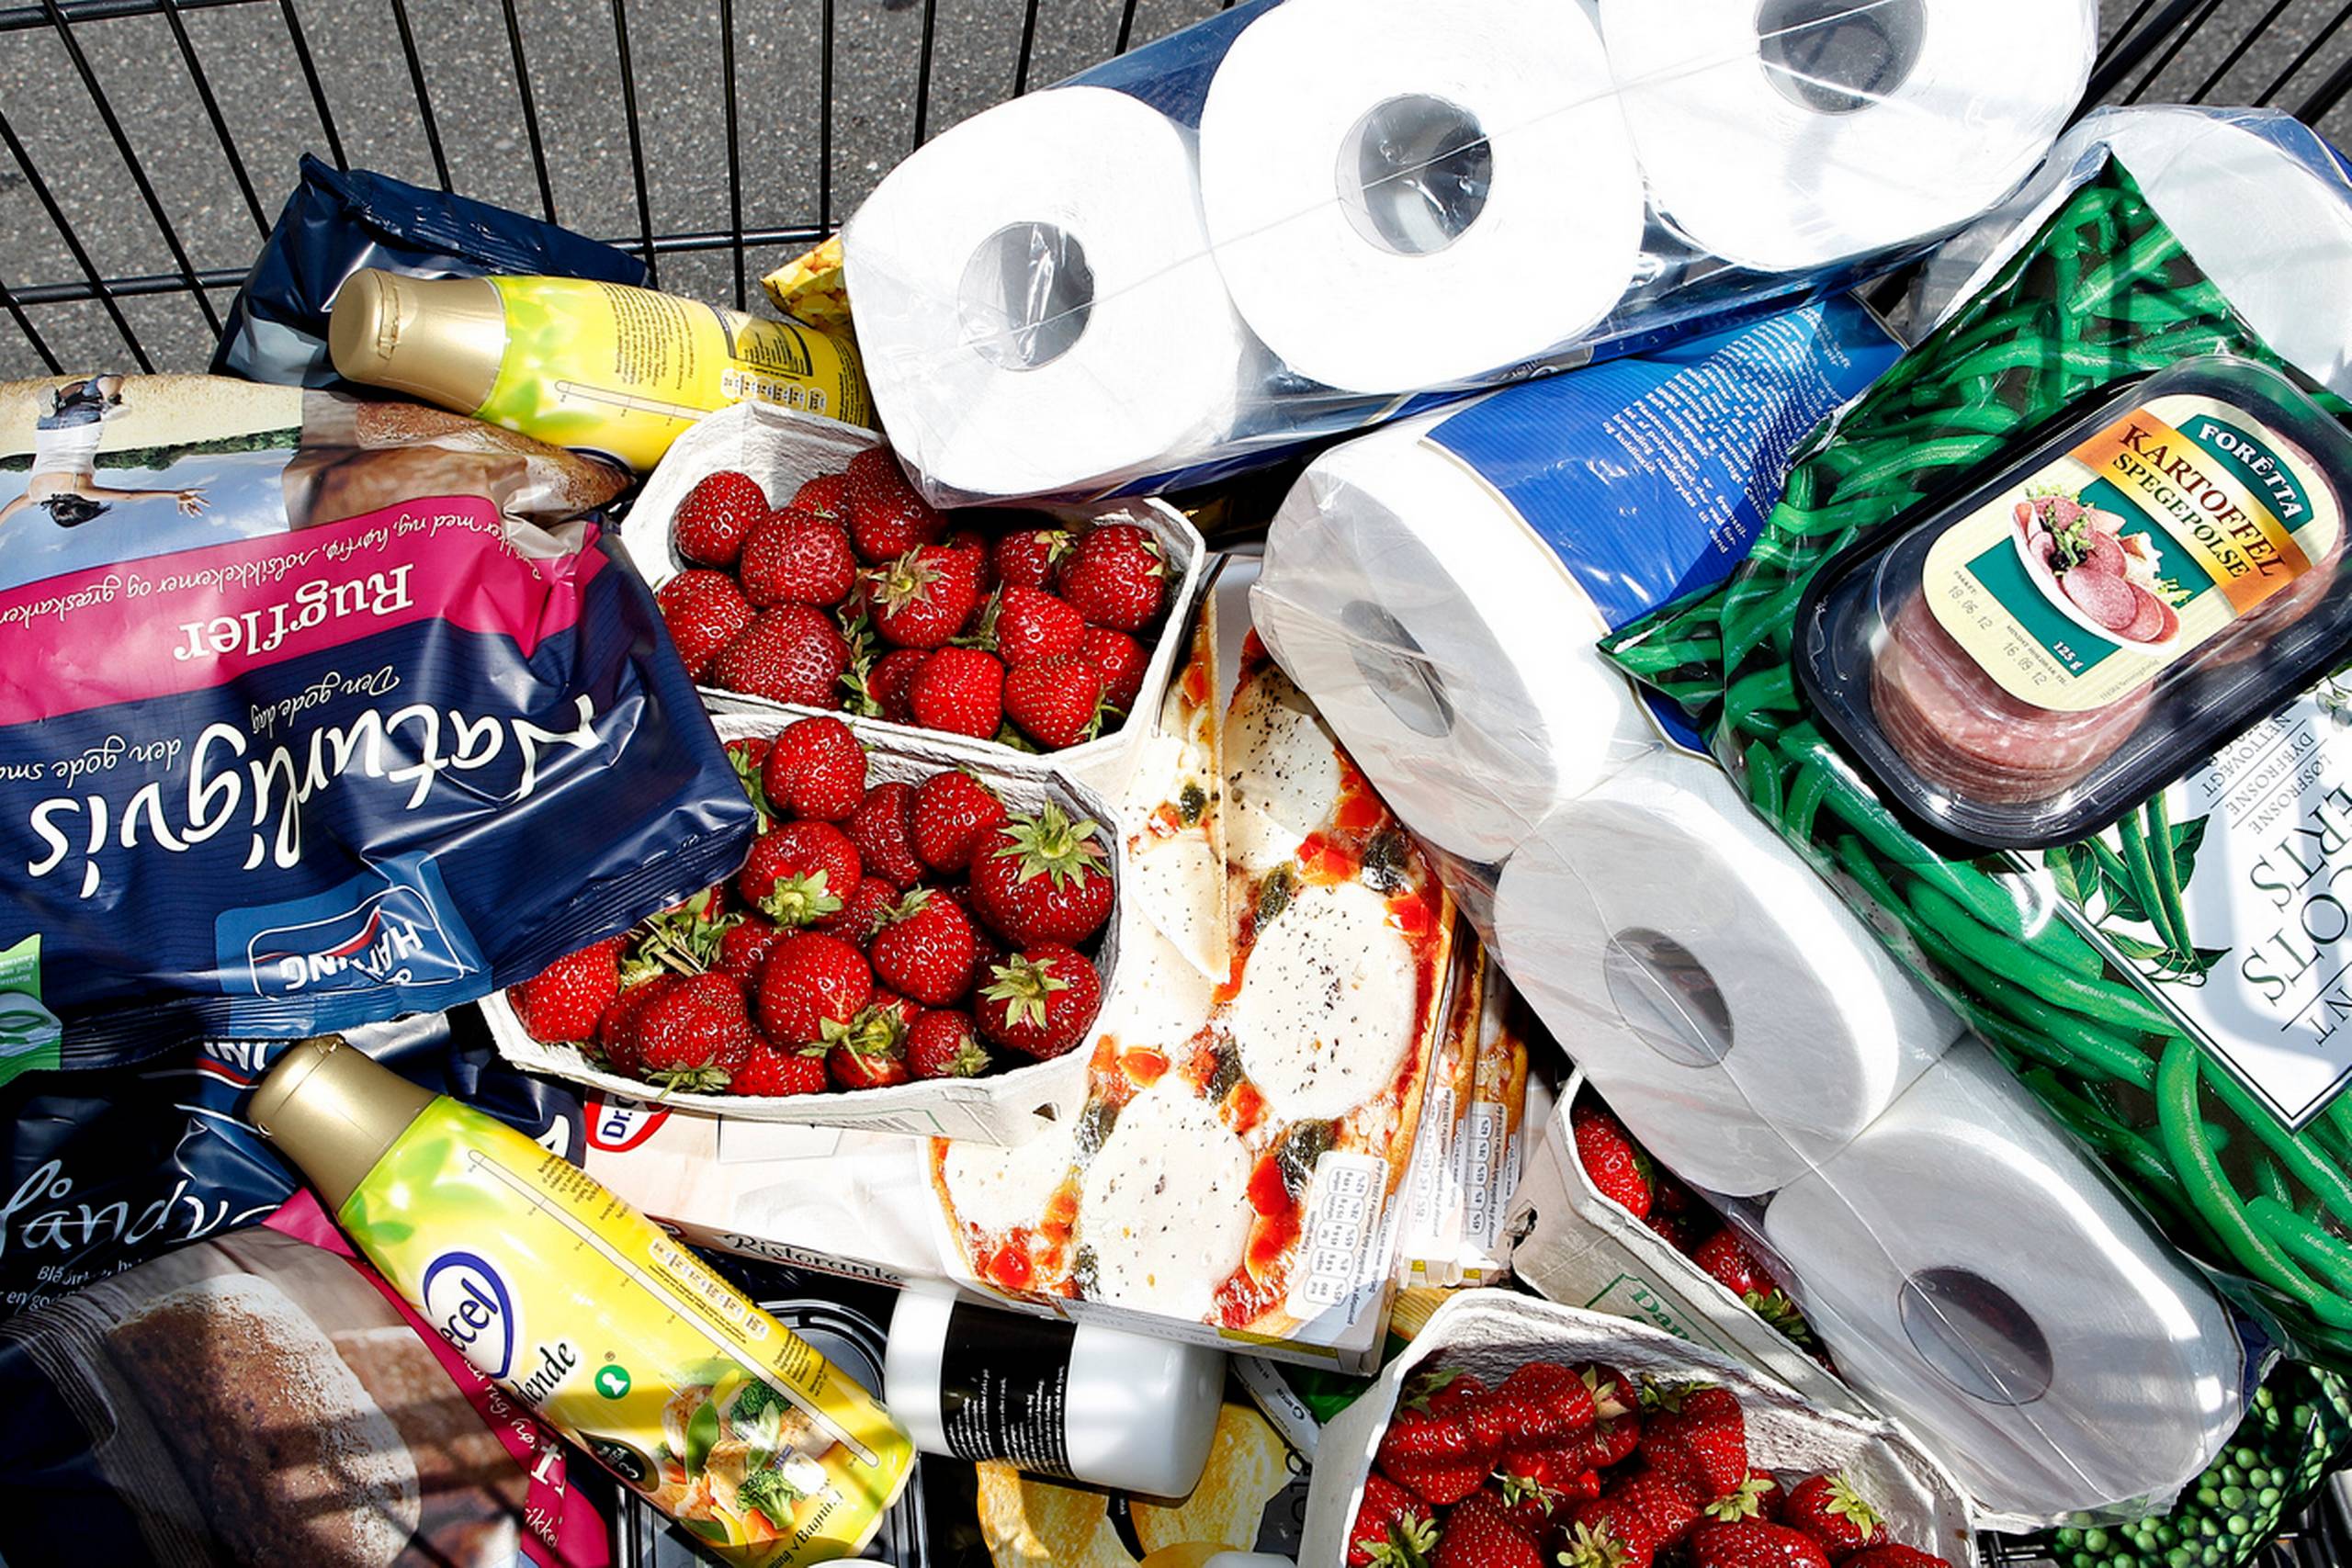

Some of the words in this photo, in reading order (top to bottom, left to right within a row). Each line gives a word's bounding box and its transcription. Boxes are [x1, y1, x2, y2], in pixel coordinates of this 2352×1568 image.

[1635, 418, 1649, 431] af
[1703, 435, 1719, 451] og
[431, 512, 477, 533] med
[2112, 454, 2251, 581] SPEGEPØLSE
[2119, 423, 2286, 578] KARTOFFEL
[122, 573, 153, 605] og
[174, 564, 416, 662] Rugfler
[336, 661, 401, 701] Den
[2052, 639, 2075, 662] 125
[2069, 658, 2084, 672] g
[247, 702, 279, 734] dag
[274, 672, 345, 720] gode
[48, 735, 130, 788] gode
[128, 736, 184, 773] den
[2201, 714, 2291, 797] NETTOVÆGT
[2225, 731, 2314, 816] DYBFROSNE
[28, 694, 602, 899] Naturligvis
[2249, 750, 2333, 835] LØSFROSNE
[722, 1232, 901, 1284] Ristorante
[1627, 1285, 1695, 1348] Dan
